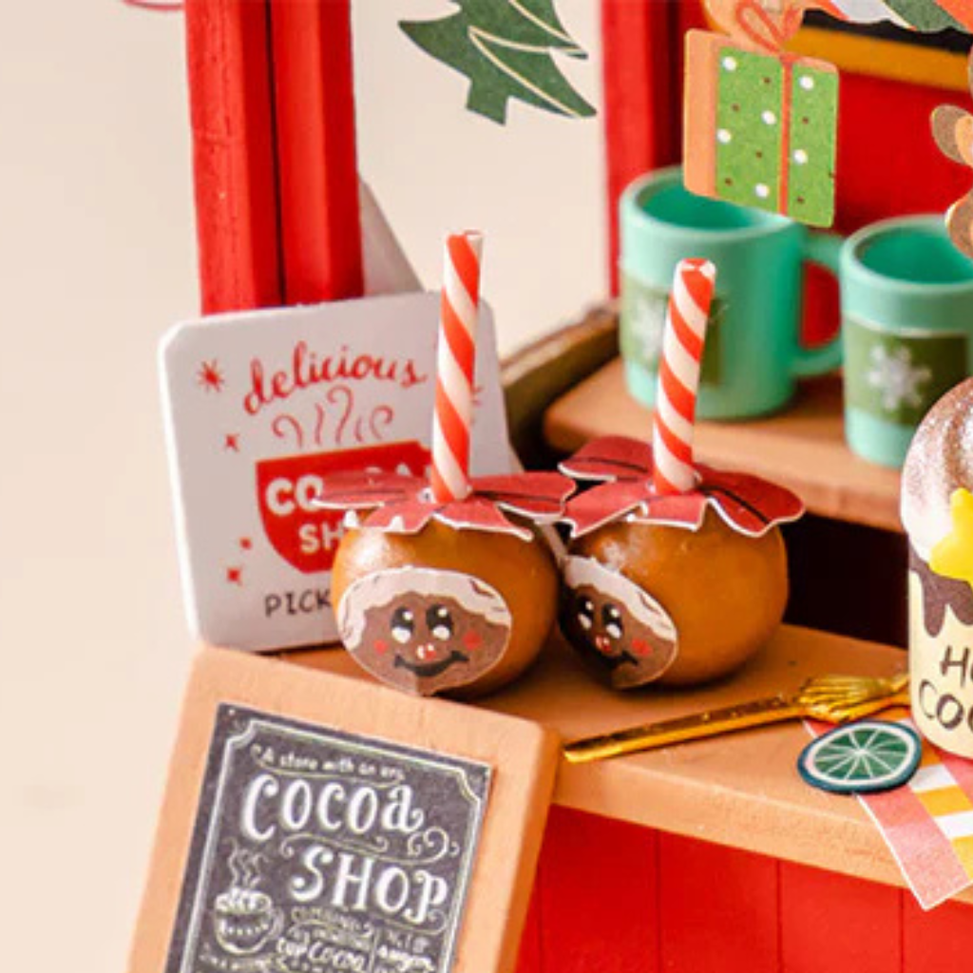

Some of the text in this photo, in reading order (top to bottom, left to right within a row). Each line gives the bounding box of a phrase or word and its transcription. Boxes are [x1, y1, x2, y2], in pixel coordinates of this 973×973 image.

[244, 341, 427, 416] delicious
[264, 588, 332, 618] PICK
[291, 845, 449, 935] SHOP
